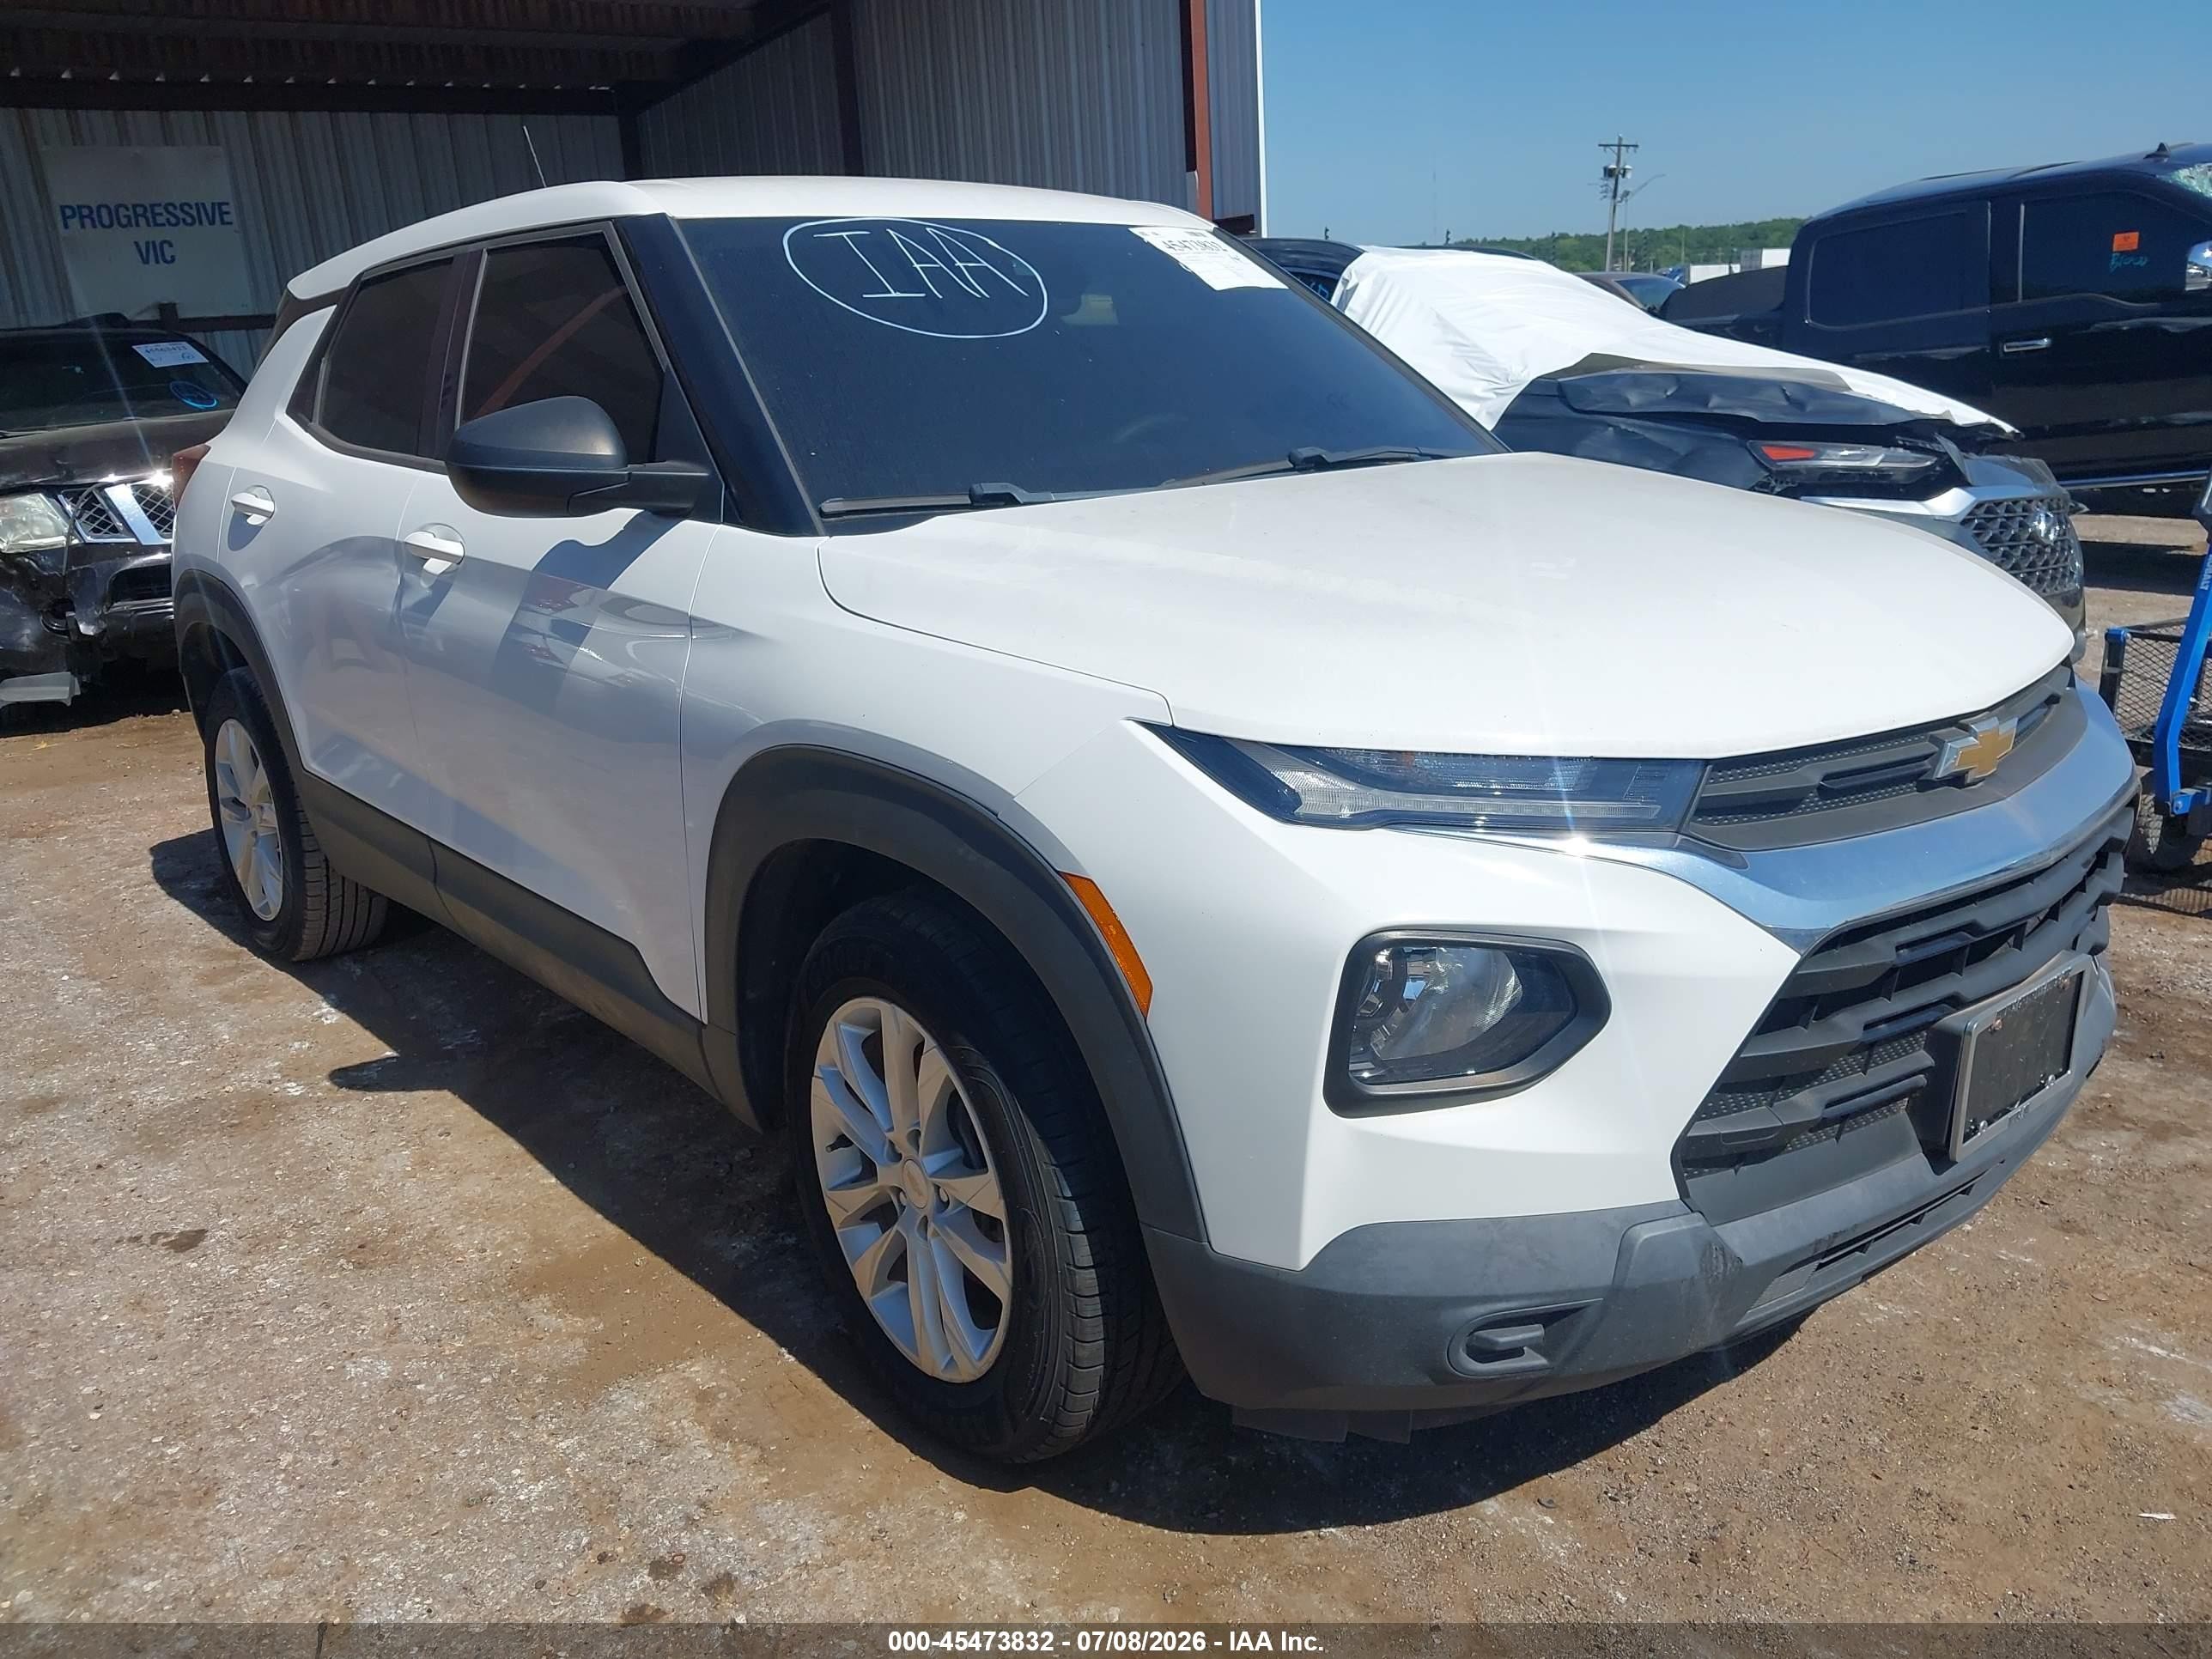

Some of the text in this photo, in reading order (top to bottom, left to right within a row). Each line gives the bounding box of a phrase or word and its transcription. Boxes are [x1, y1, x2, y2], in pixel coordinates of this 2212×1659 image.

[59, 202, 233, 229] PROGRESSIVE
[133, 239, 176, 264] VIC
[813, 227, 1030, 299] IAA
